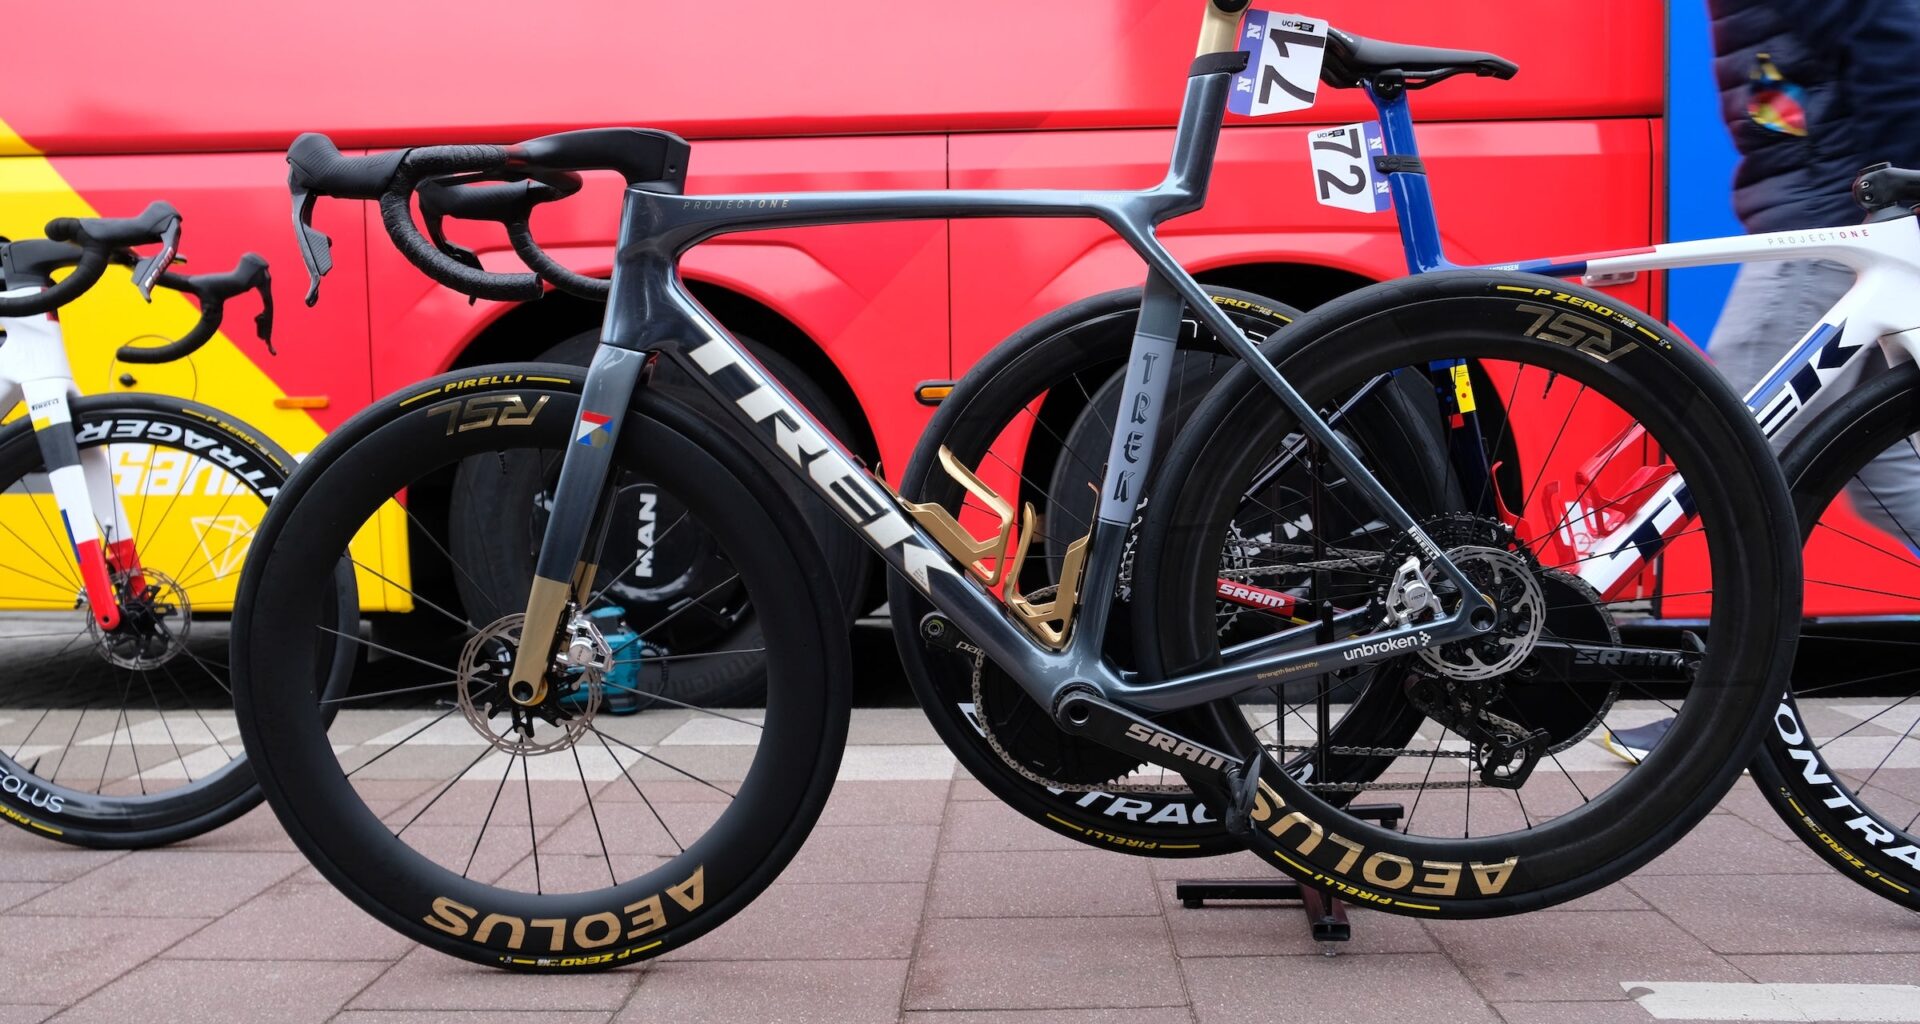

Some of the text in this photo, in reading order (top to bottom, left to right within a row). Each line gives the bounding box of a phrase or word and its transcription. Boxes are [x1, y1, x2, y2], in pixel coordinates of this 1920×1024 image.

[1258, 28, 1326, 105] 71
[1313, 128, 1366, 200] 72
[1552, 292, 1613, 317] ZERO
[444, 374, 523, 393] PIRELLI
[1113, 351, 1160, 503] TREK
[688, 314, 960, 597] TREK
[635, 492, 657, 578] MAN
[1218, 583, 1287, 608] SRAM
[1343, 634, 1418, 661] unbroken
[1125, 723, 1230, 770] SRAM
[1085, 828, 1158, 850] PIRELLI
[1250, 777, 1520, 897] AEOLUS
[1818, 832, 1867, 869] ZERO
[422, 864, 705, 951] AEOLUS
[1312, 873, 1394, 906] PIRELLI
[561, 953, 614, 967] ZERO
